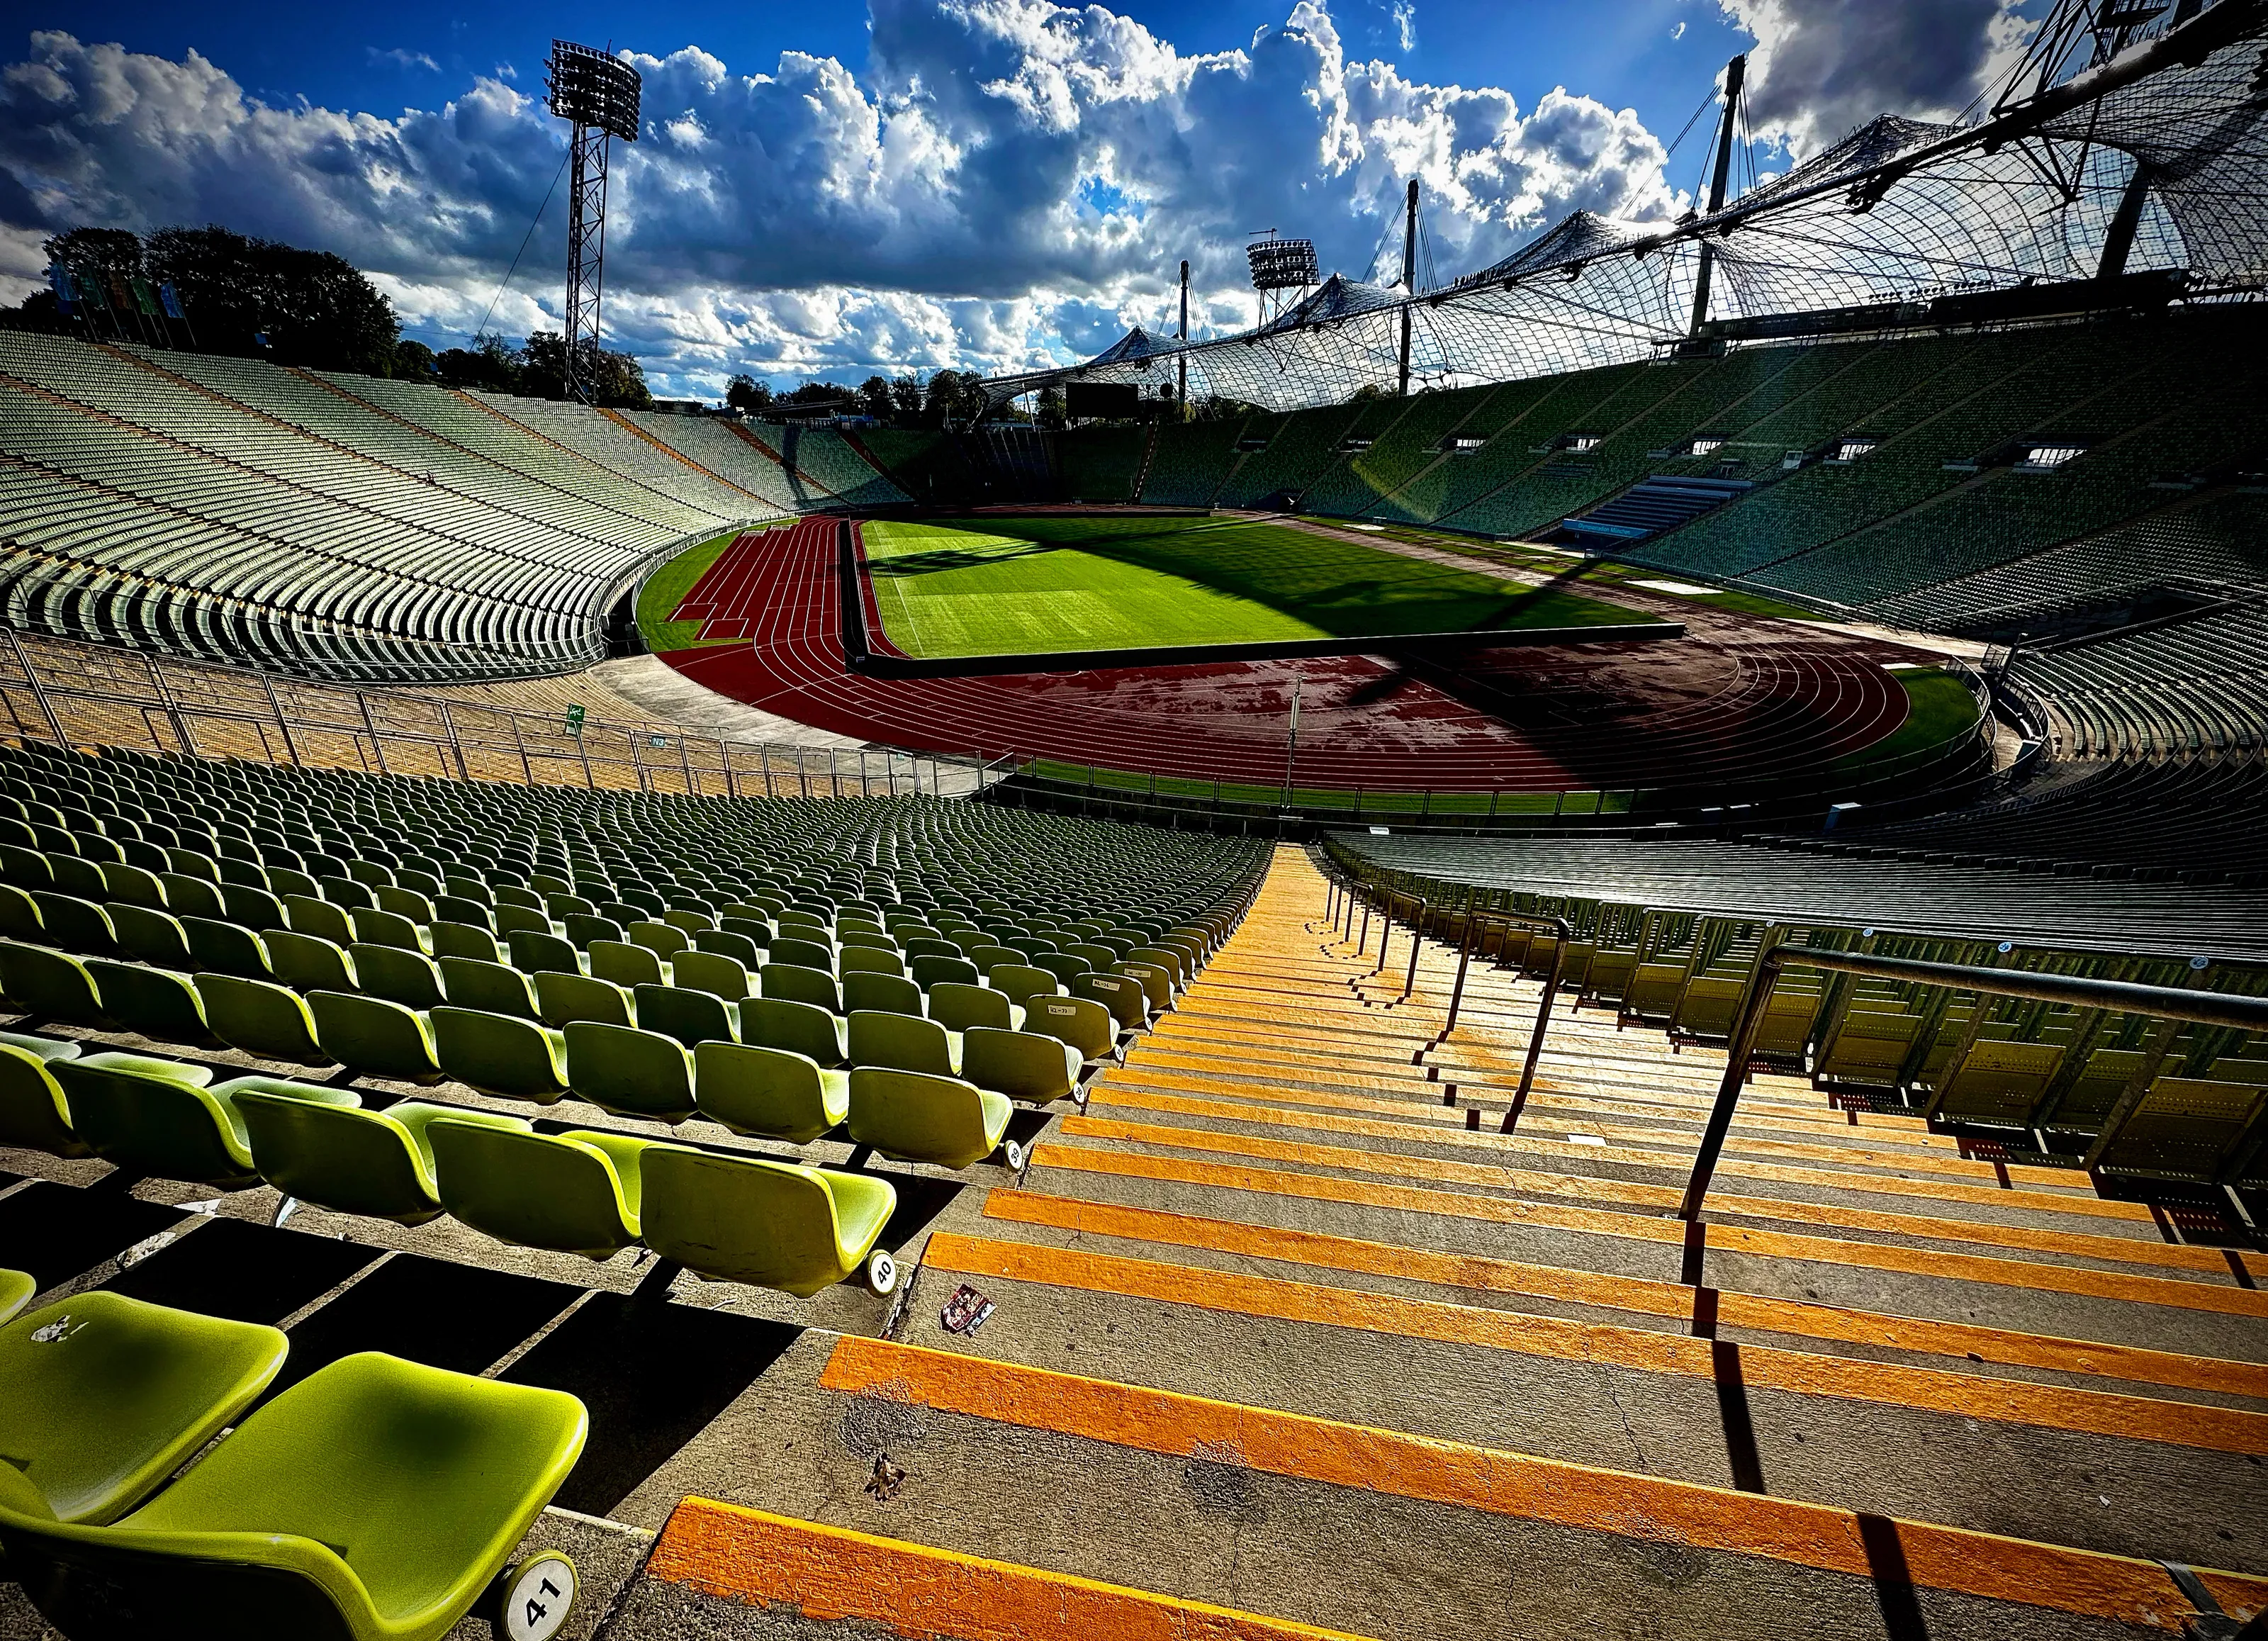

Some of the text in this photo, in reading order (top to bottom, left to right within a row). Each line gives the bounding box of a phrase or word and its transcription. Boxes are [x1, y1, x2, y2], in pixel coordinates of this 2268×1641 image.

[653, 737, 664, 746] N3
[1076, 1087, 1082, 1099] 38
[1011, 1148, 1019, 1163] 39
[877, 1260, 892, 1284] 40
[525, 1576, 561, 1628] 41
